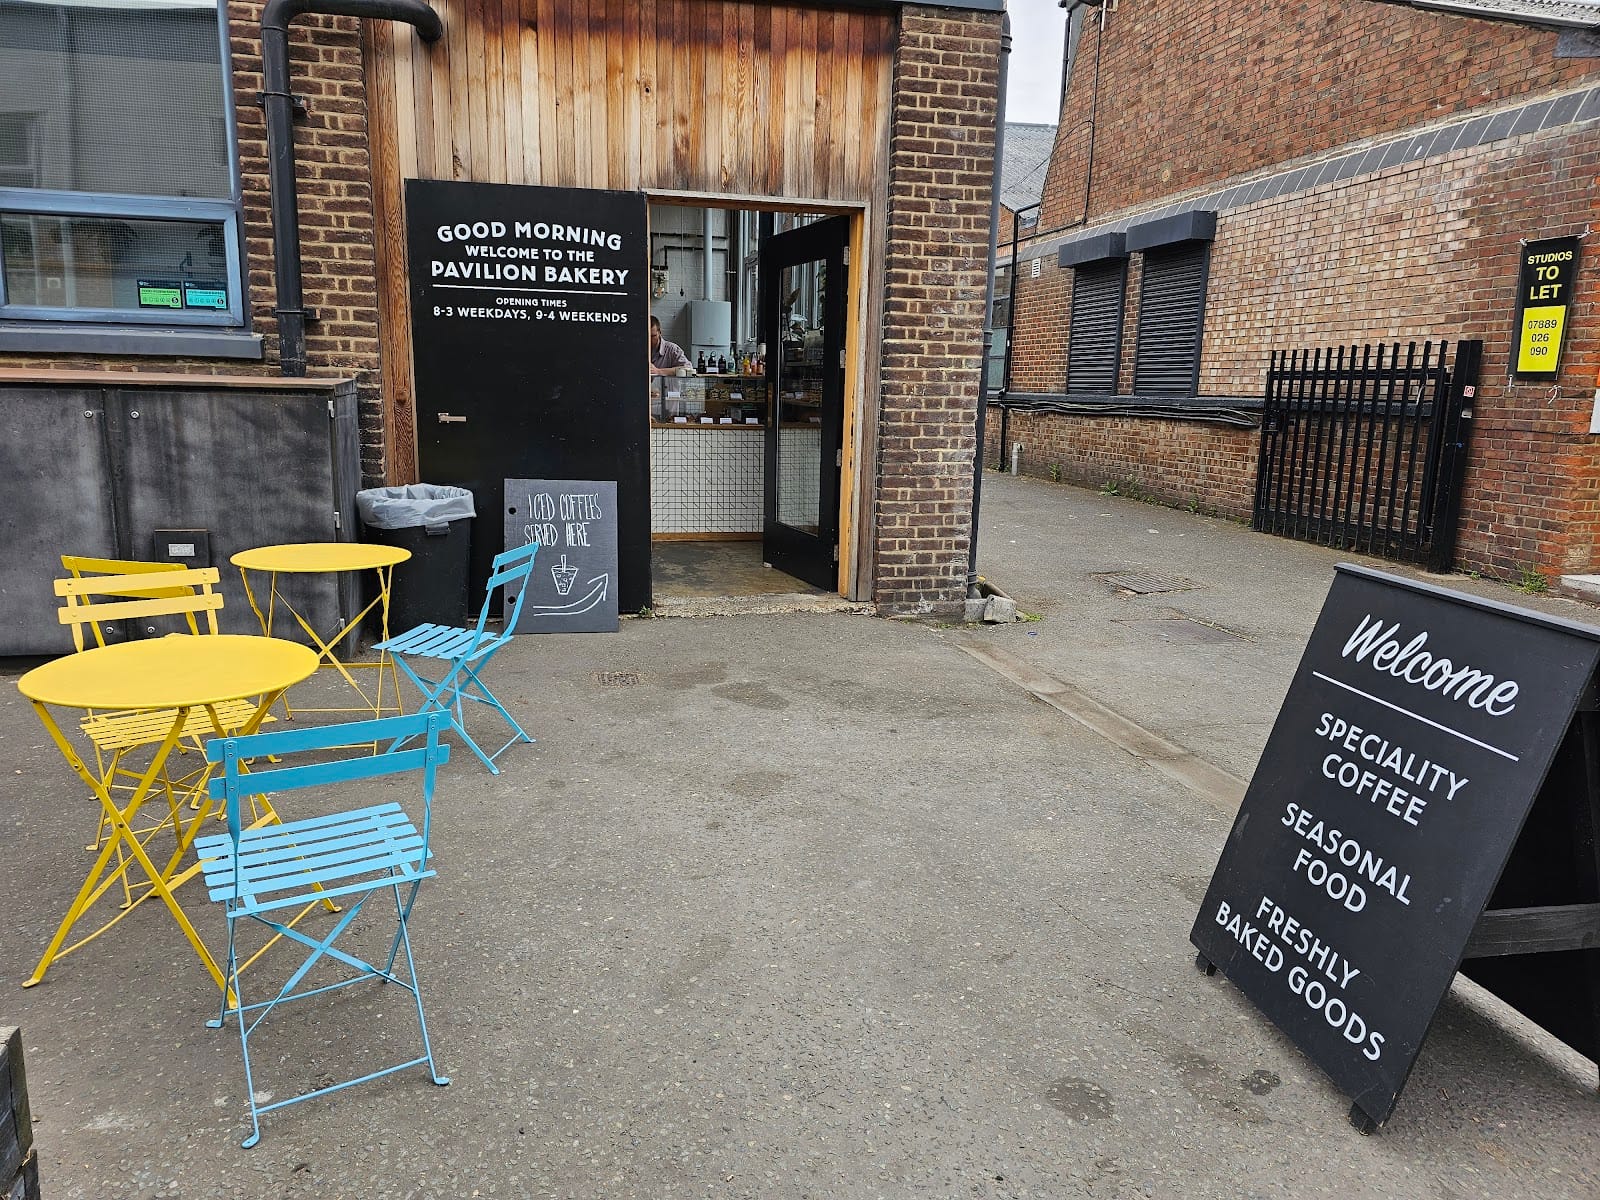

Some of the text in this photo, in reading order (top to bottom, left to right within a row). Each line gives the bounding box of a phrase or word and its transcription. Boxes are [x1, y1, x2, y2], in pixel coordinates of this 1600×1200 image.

[436, 221, 622, 251] GOOD MORNING
[464, 244, 596, 263] WELCOME TO THE
[1527, 251, 1573, 265] STUDIOS
[431, 260, 630, 286] PAVILION BAKERY
[1535, 265, 1560, 281] TO
[495, 297, 568, 308] OPENING TIMES
[1530, 284, 1562, 299] LET
[432, 306, 629, 323] 8-3 WEEKDAYS, 9-4 WEEKENDS
[1528, 319, 1557, 329] 07889
[1530, 346, 1548, 356] 090
[528, 492, 602, 521] ICED COFFEES
[524, 521, 591, 547] SERVED HERE
[1341, 613, 1520, 717] Welcome
[1314, 712, 1470, 801] SPECIALITY
[1322, 753, 1428, 827] COFFEE
[1280, 802, 1412, 906] SEASONAL
[1292, 847, 1368, 914] FOOD
[1255, 895, 1361, 991] FRESHLY
[1214, 900, 1386, 1062] BAKED GOODS
